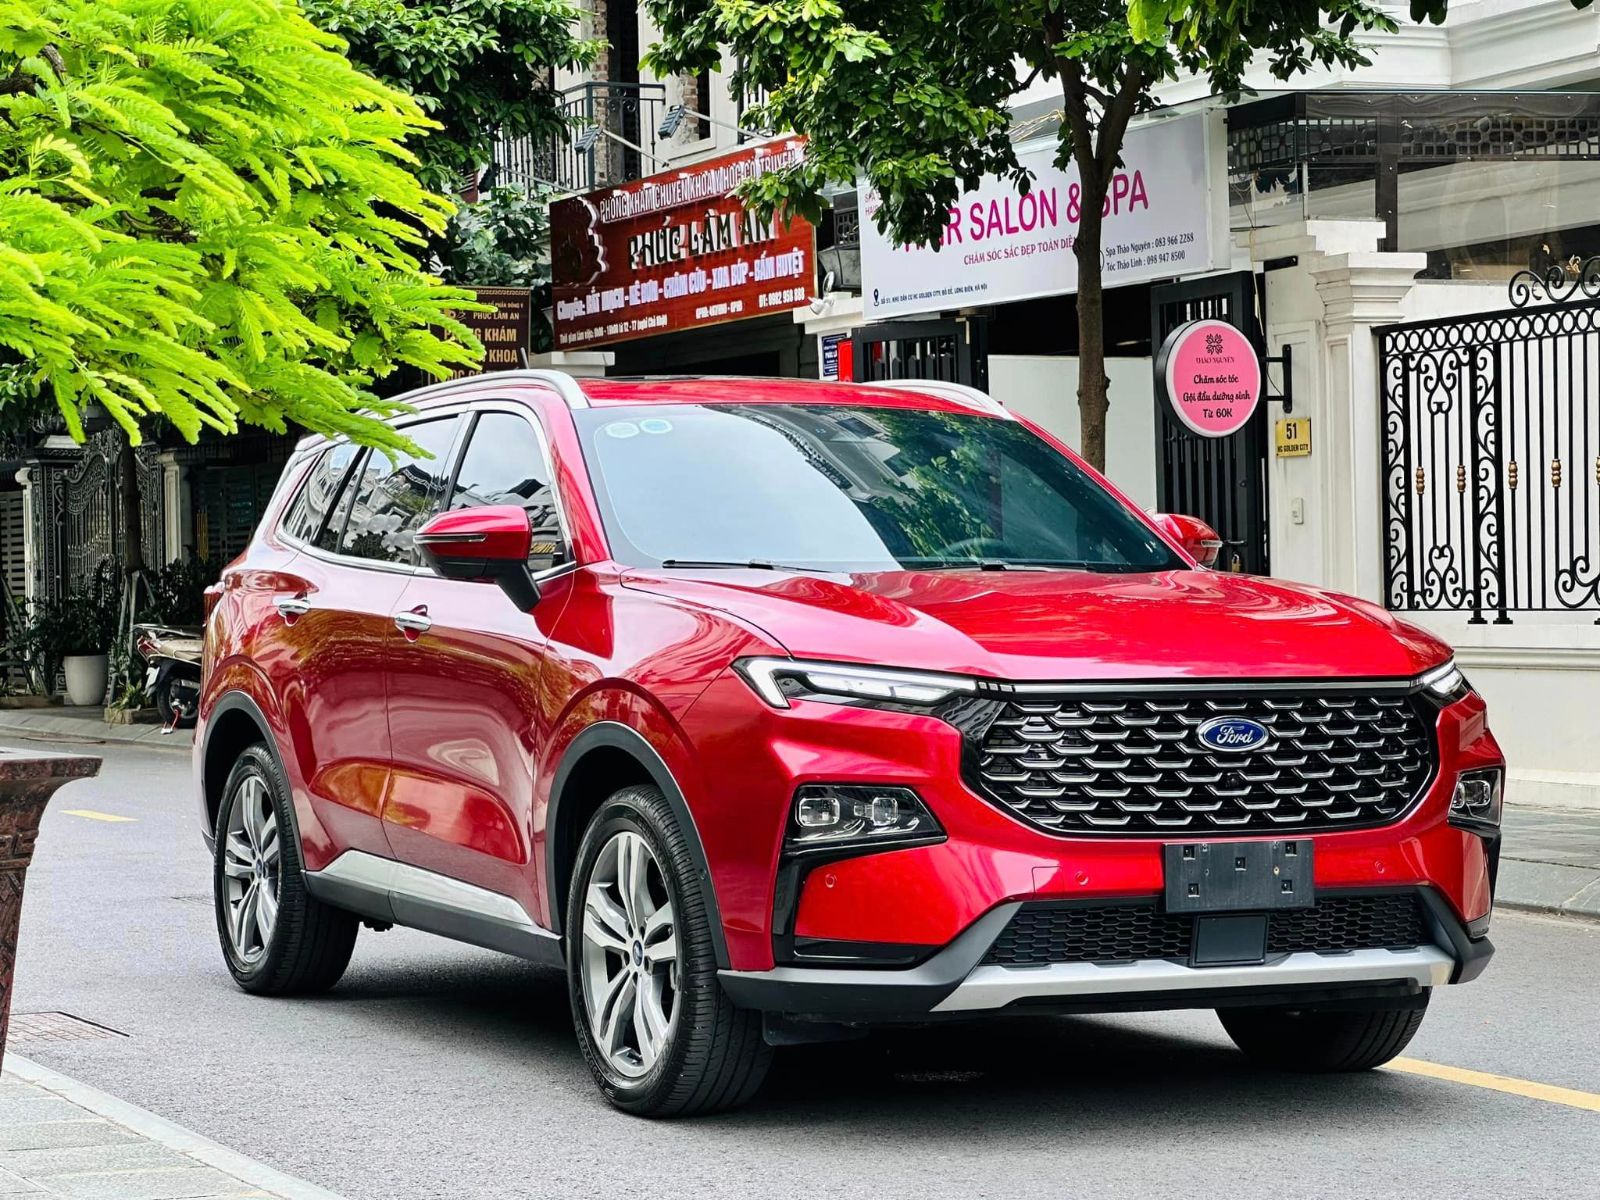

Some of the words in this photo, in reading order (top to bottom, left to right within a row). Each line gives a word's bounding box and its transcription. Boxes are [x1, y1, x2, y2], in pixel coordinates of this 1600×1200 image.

[970, 187, 1057, 241] SALON
[1066, 183, 1081, 223] &
[987, 246, 1002, 261] SÓC
[1038, 238, 1059, 253] TOÀN
[1106, 247, 1116, 258] Spa
[1117, 244, 1129, 255] Thảo
[1131, 241, 1150, 254] Nguyên
[1155, 237, 1166, 248] 083
[1168, 234, 1178, 245] 966
[1107, 261, 1116, 272] Tóc
[1117, 259, 1129, 270] Thảo
[1131, 257, 1142, 268] Linh
[1147, 254, 1157, 265] 098
[1159, 252, 1169, 263] 947
[1171, 250, 1185, 261] 8500
[485, 326, 517, 341] KHÁM
[489, 349, 518, 362] KHOA
[1193, 374, 1215, 384] Chăm
[1216, 375, 1227, 384] sóc
[1228, 374, 1239, 383] tóc
[1183, 392, 1196, 403] Gội
[1197, 391, 1211, 401] đầu
[1235, 390, 1250, 400] sinh
[1216, 408, 1232, 418] 60K
[1286, 422, 1297, 440] 51
[1284, 444, 1299, 452] GOLDEN
[1300, 443, 1309, 451] CITY
[1216, 725, 1255, 744] Ford
